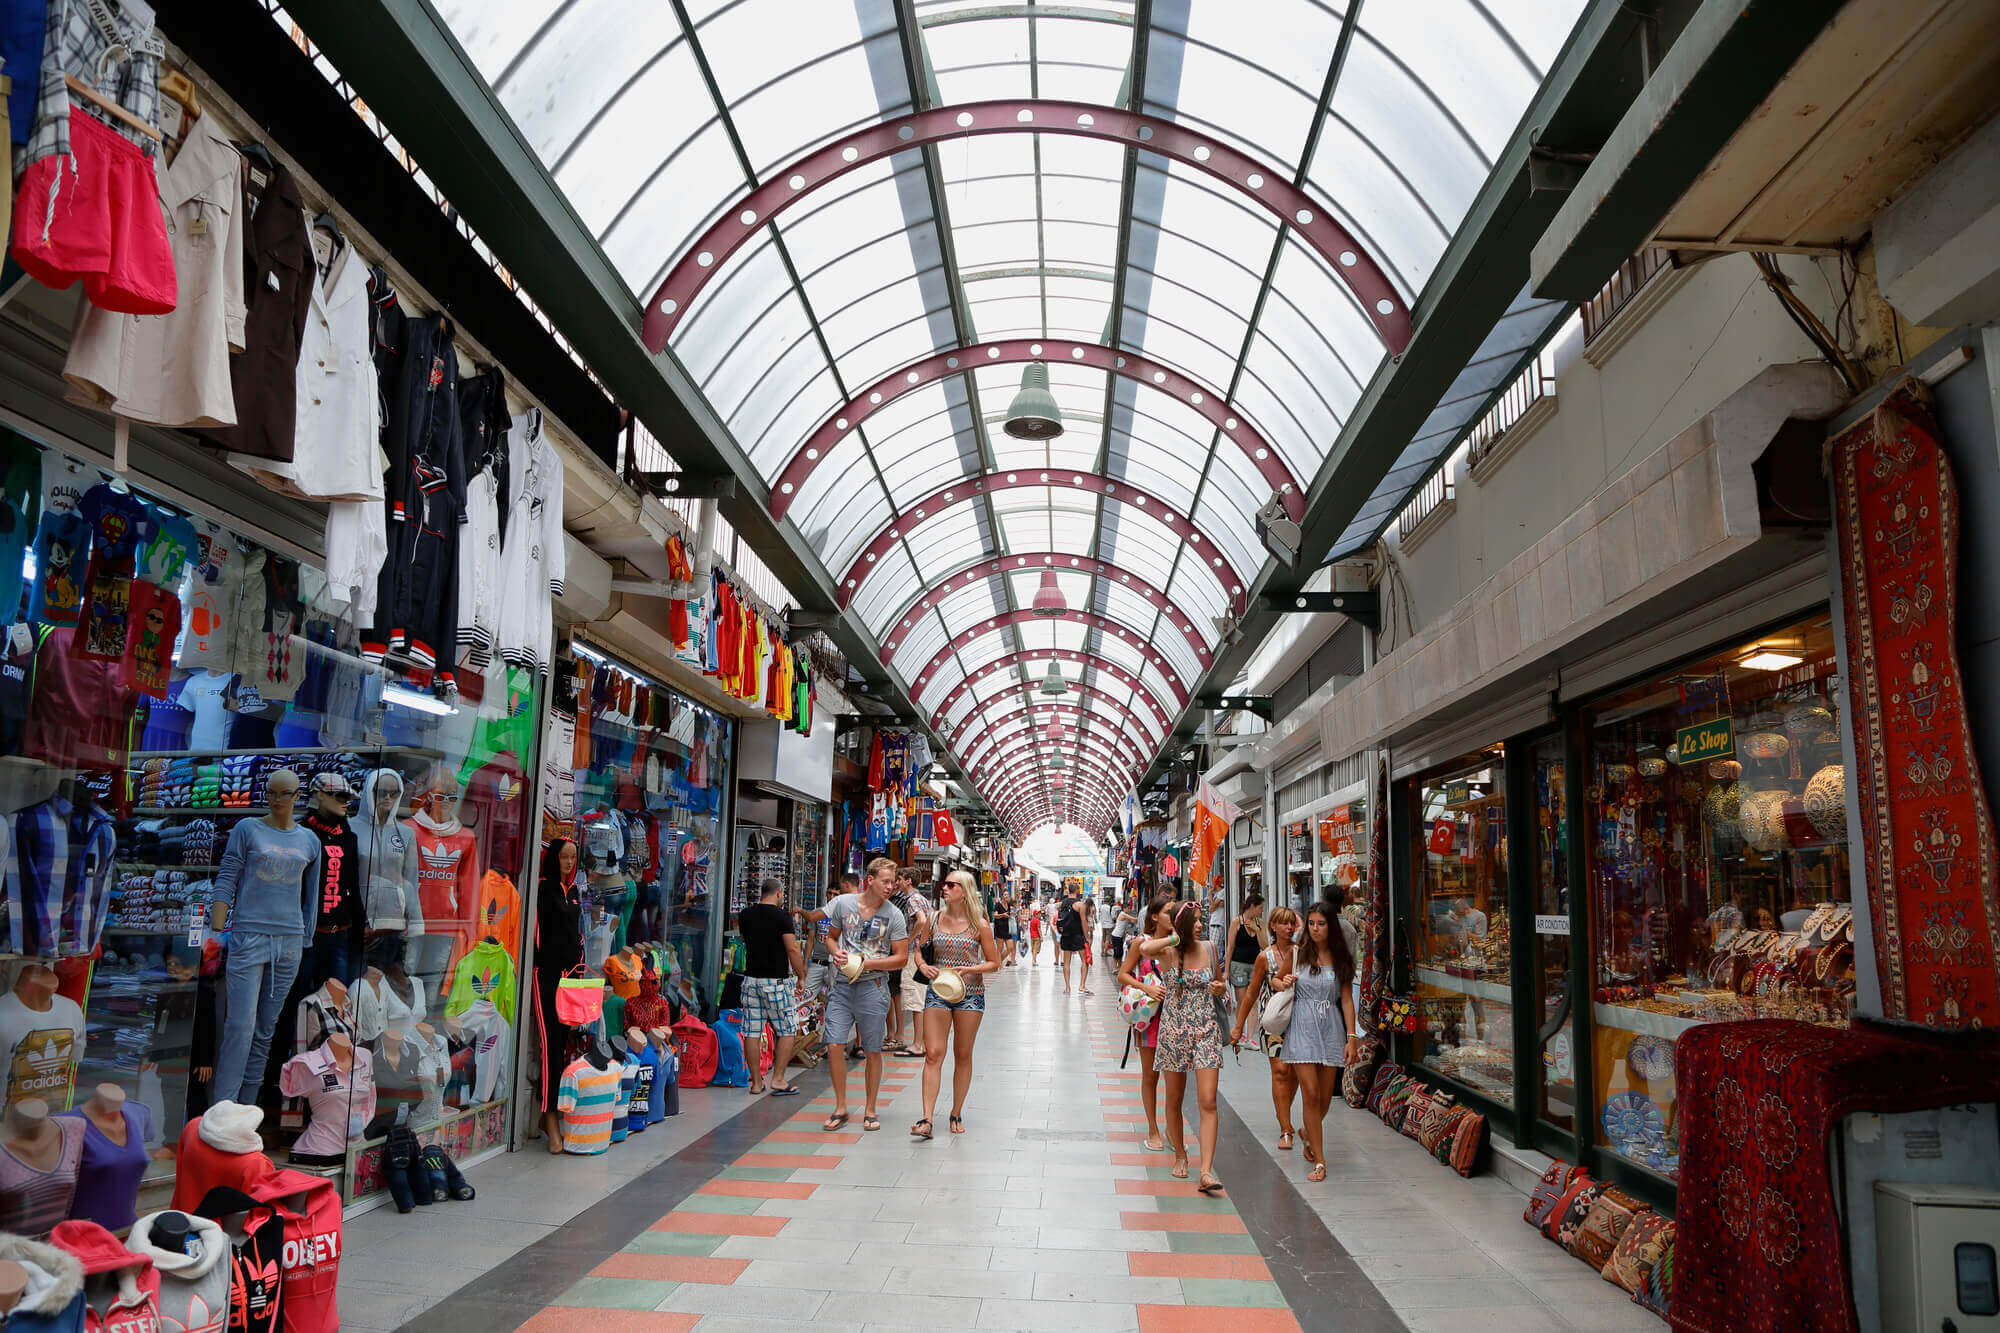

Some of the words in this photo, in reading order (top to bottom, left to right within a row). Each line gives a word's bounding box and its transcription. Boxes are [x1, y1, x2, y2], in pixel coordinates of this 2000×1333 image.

[88, 0, 107, 23] TAR
[145, 40, 163, 53] G-ST
[1681, 734, 1697, 755] Le
[1699, 731, 1728, 752] Shop
[890, 757, 902, 769] 24
[1537, 919, 1545, 929] AIR
[21, 1074, 68, 1090] adidas
